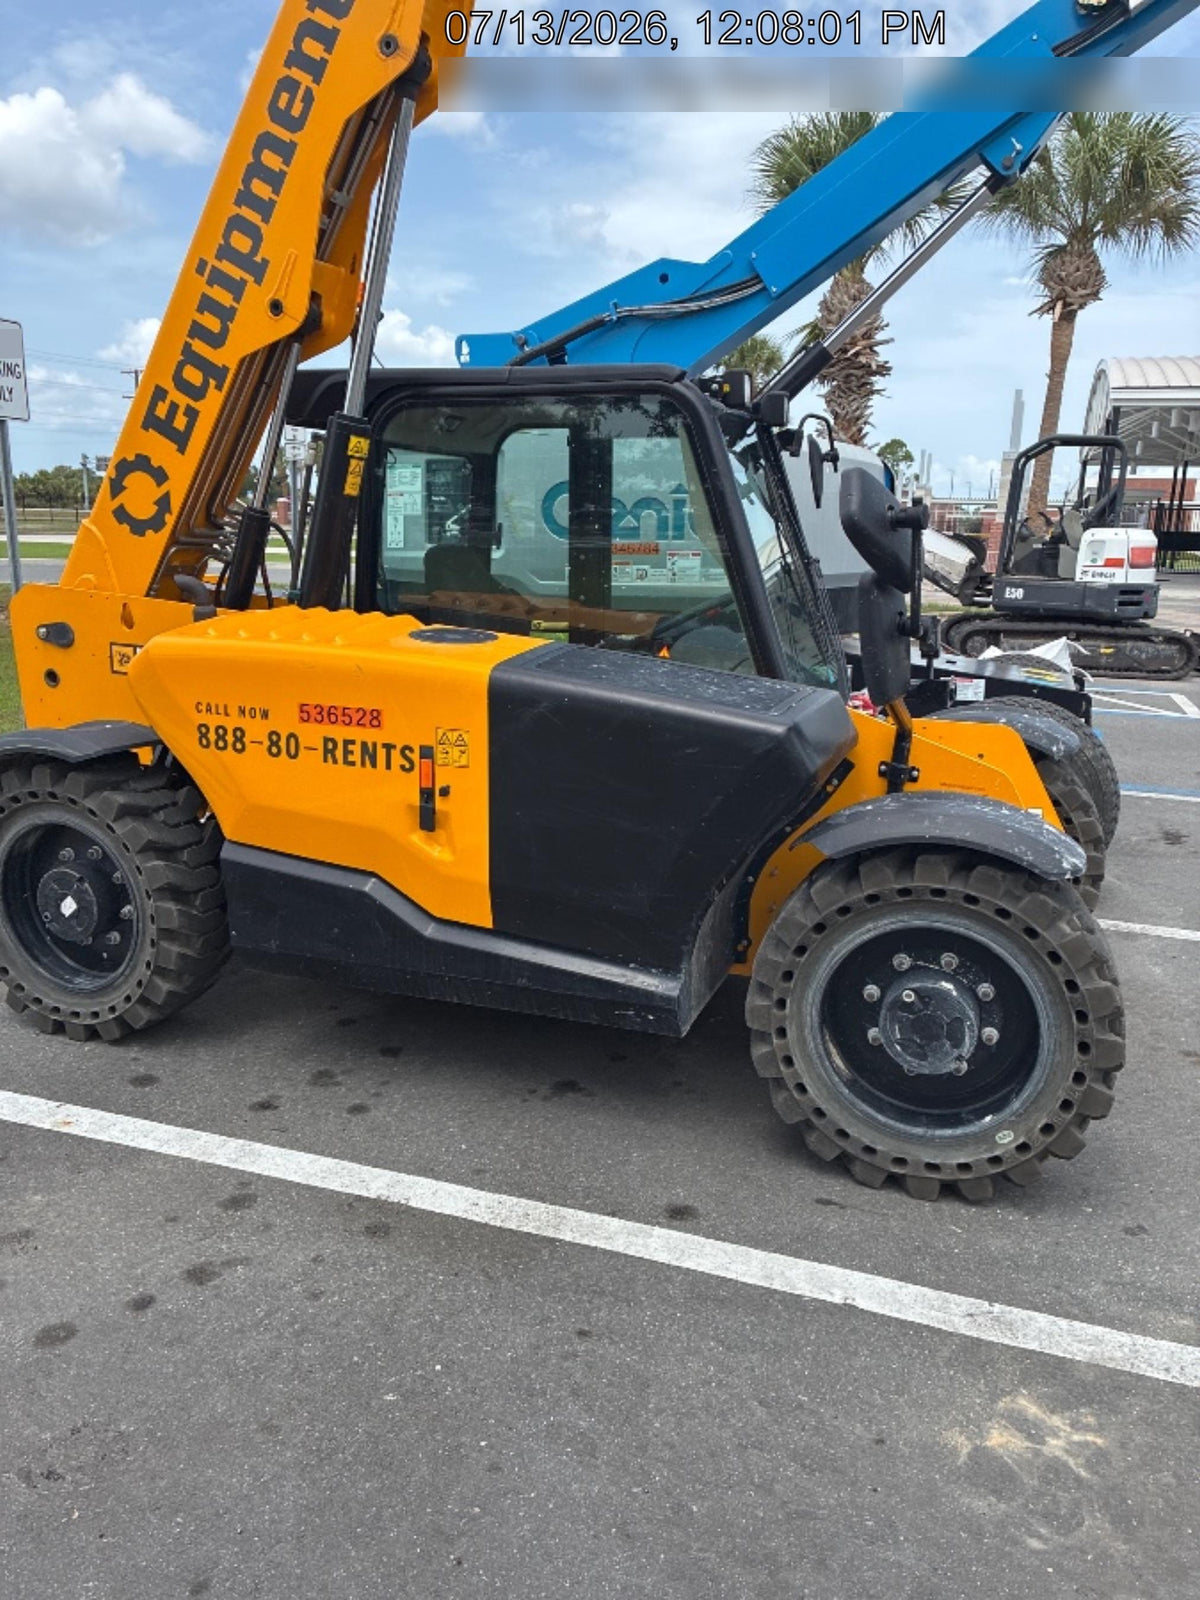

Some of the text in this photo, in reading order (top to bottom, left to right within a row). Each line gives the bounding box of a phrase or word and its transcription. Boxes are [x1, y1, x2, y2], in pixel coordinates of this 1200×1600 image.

[1005, 586, 1024, 599] E50
[195, 701, 270, 721] CALL NOW
[299, 703, 382, 728] 536528
[196, 722, 415, 774] 888-80-RENTS
